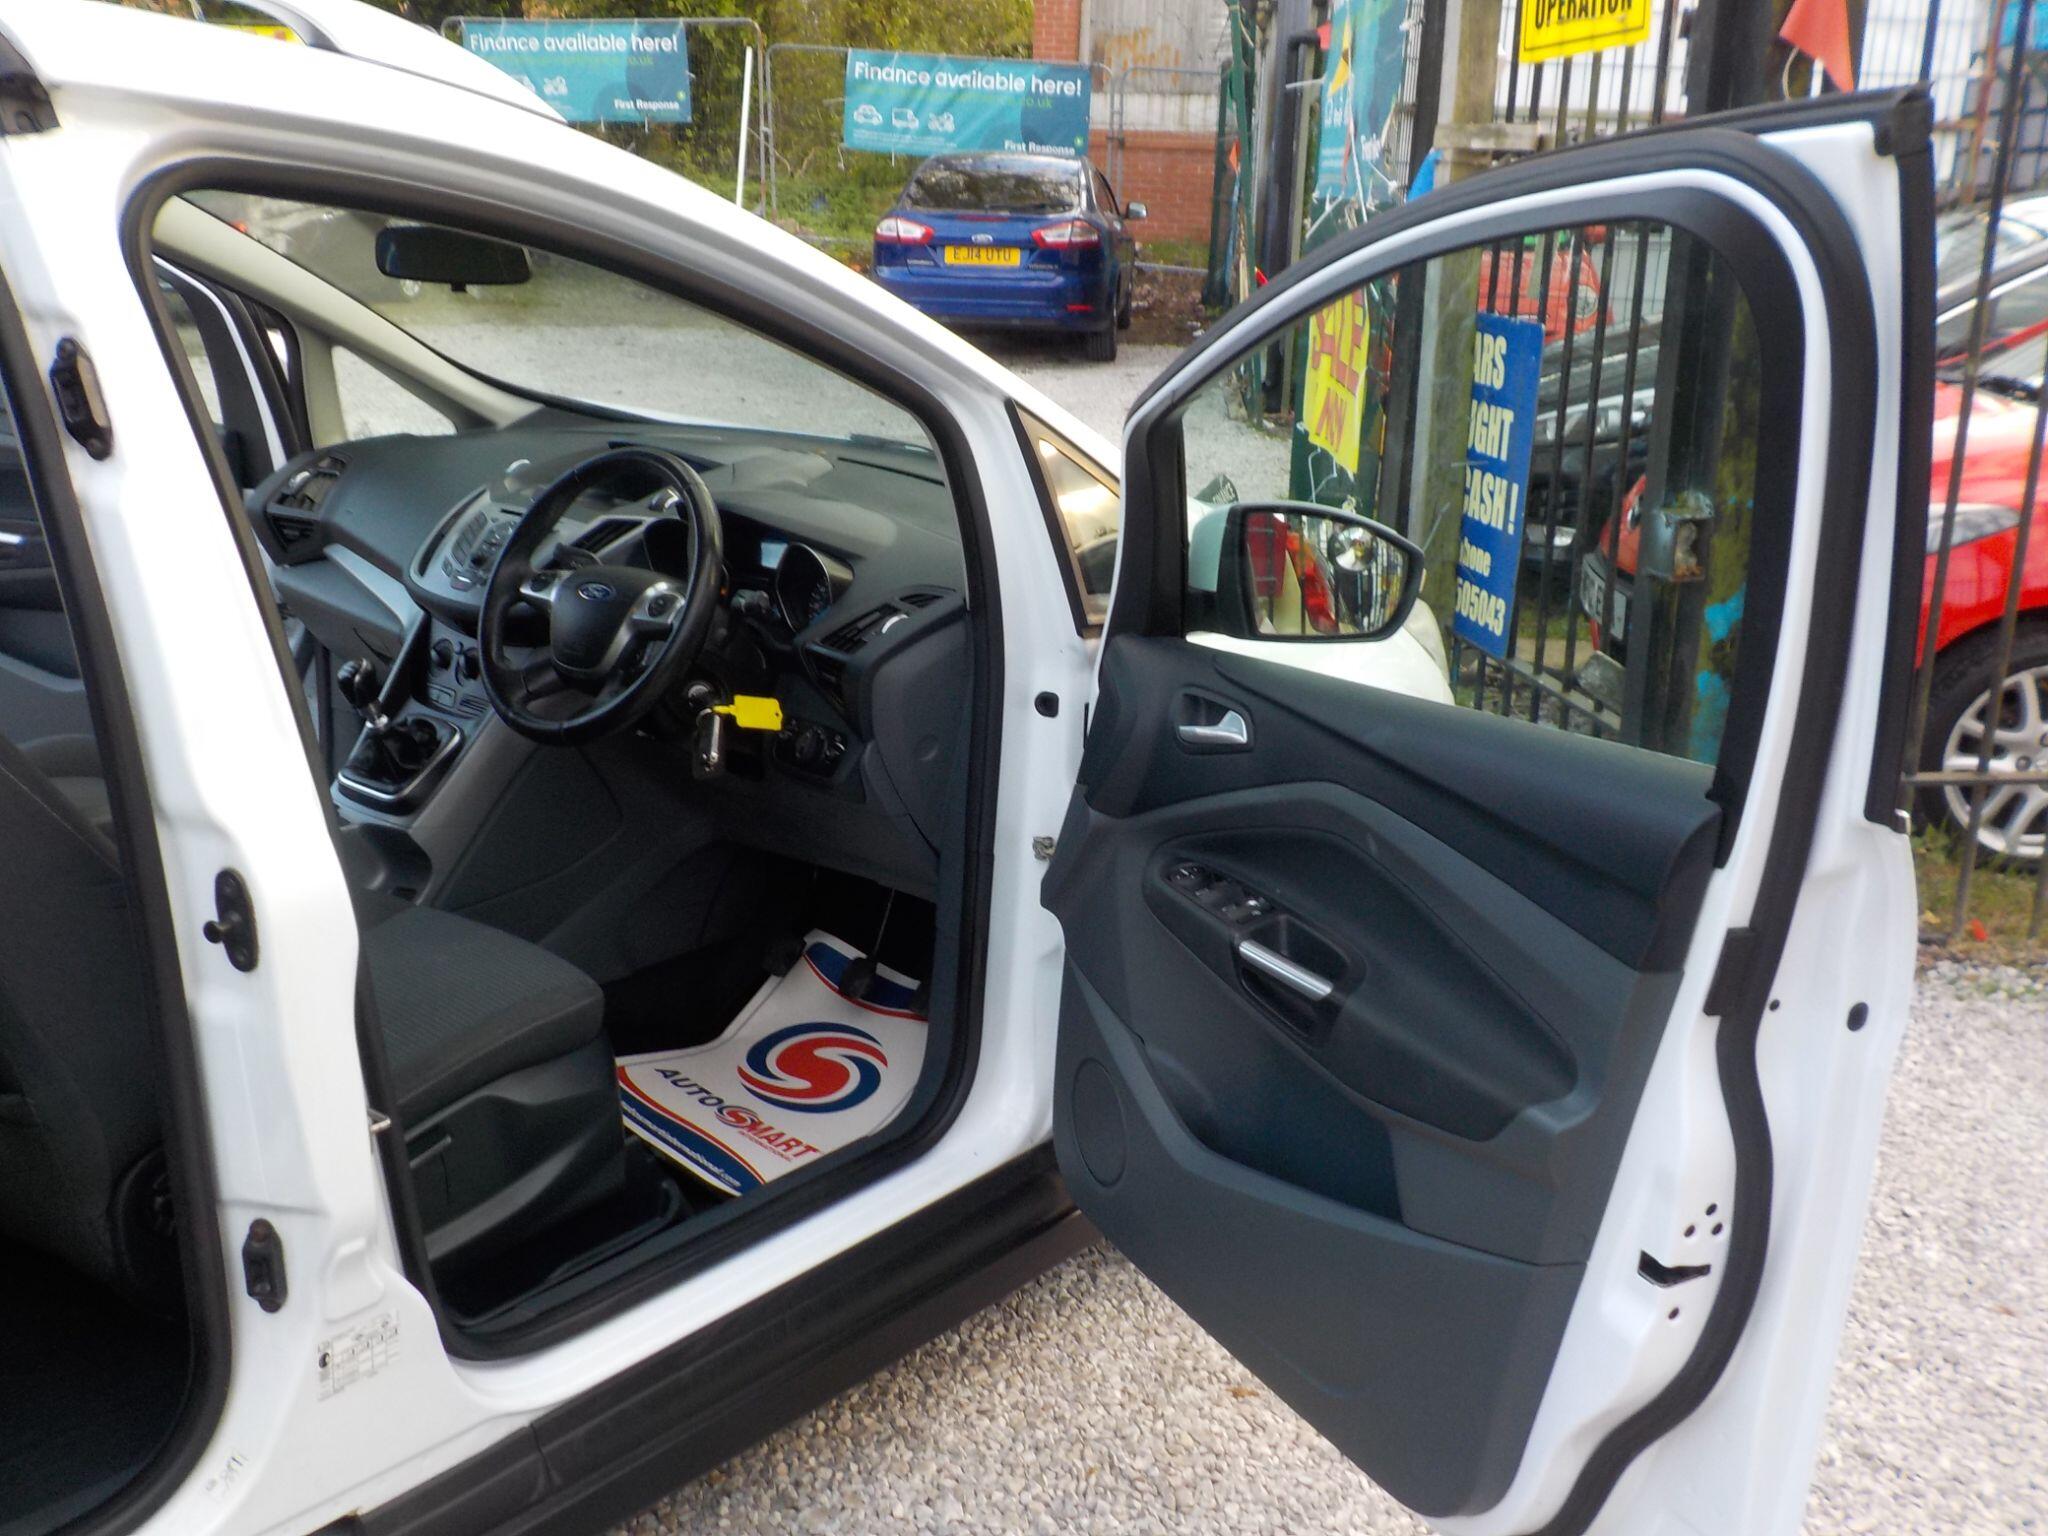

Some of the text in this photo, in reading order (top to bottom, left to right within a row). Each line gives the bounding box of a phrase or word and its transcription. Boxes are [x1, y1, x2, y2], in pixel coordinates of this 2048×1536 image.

[1535, 0, 1633, 29] OPERA
[470, 32, 678, 52] Finance available here!
[854, 61, 931, 86] Finance
[935, 69, 1026, 92] available
[1031, 74, 1082, 97] here!
[614, 98, 680, 112] First Response
[1004, 139, 1075, 155] First Response
